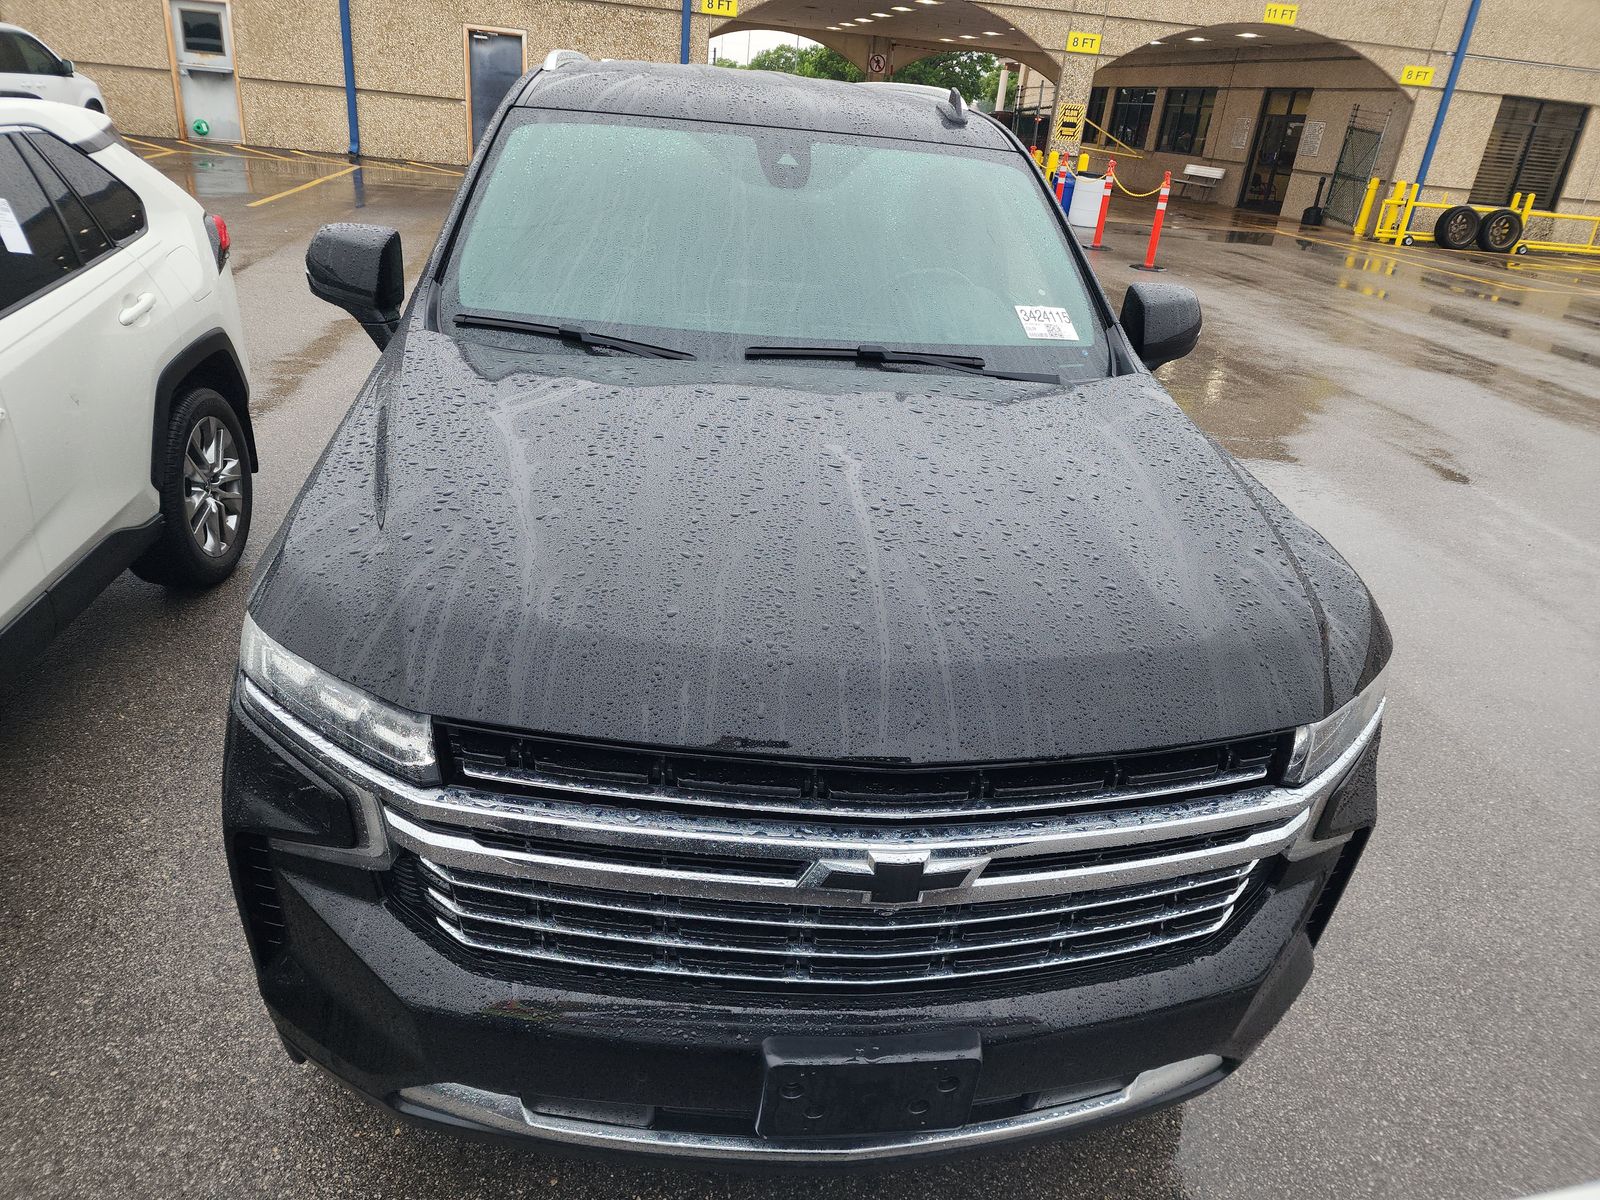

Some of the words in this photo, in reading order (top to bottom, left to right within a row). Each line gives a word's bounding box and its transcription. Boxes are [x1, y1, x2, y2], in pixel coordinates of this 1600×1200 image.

[707, 0, 714, 9] 8
[717, 0, 732, 11] FT
[1267, 8, 1278, 18] 11
[1280, 9, 1295, 20] FT
[1072, 37, 1079, 47] 8
[1081, 37, 1096, 48] FT
[1406, 70, 1413, 80] 8
[1415, 70, 1430, 81] FT
[1020, 309, 1071, 324] 3424115
